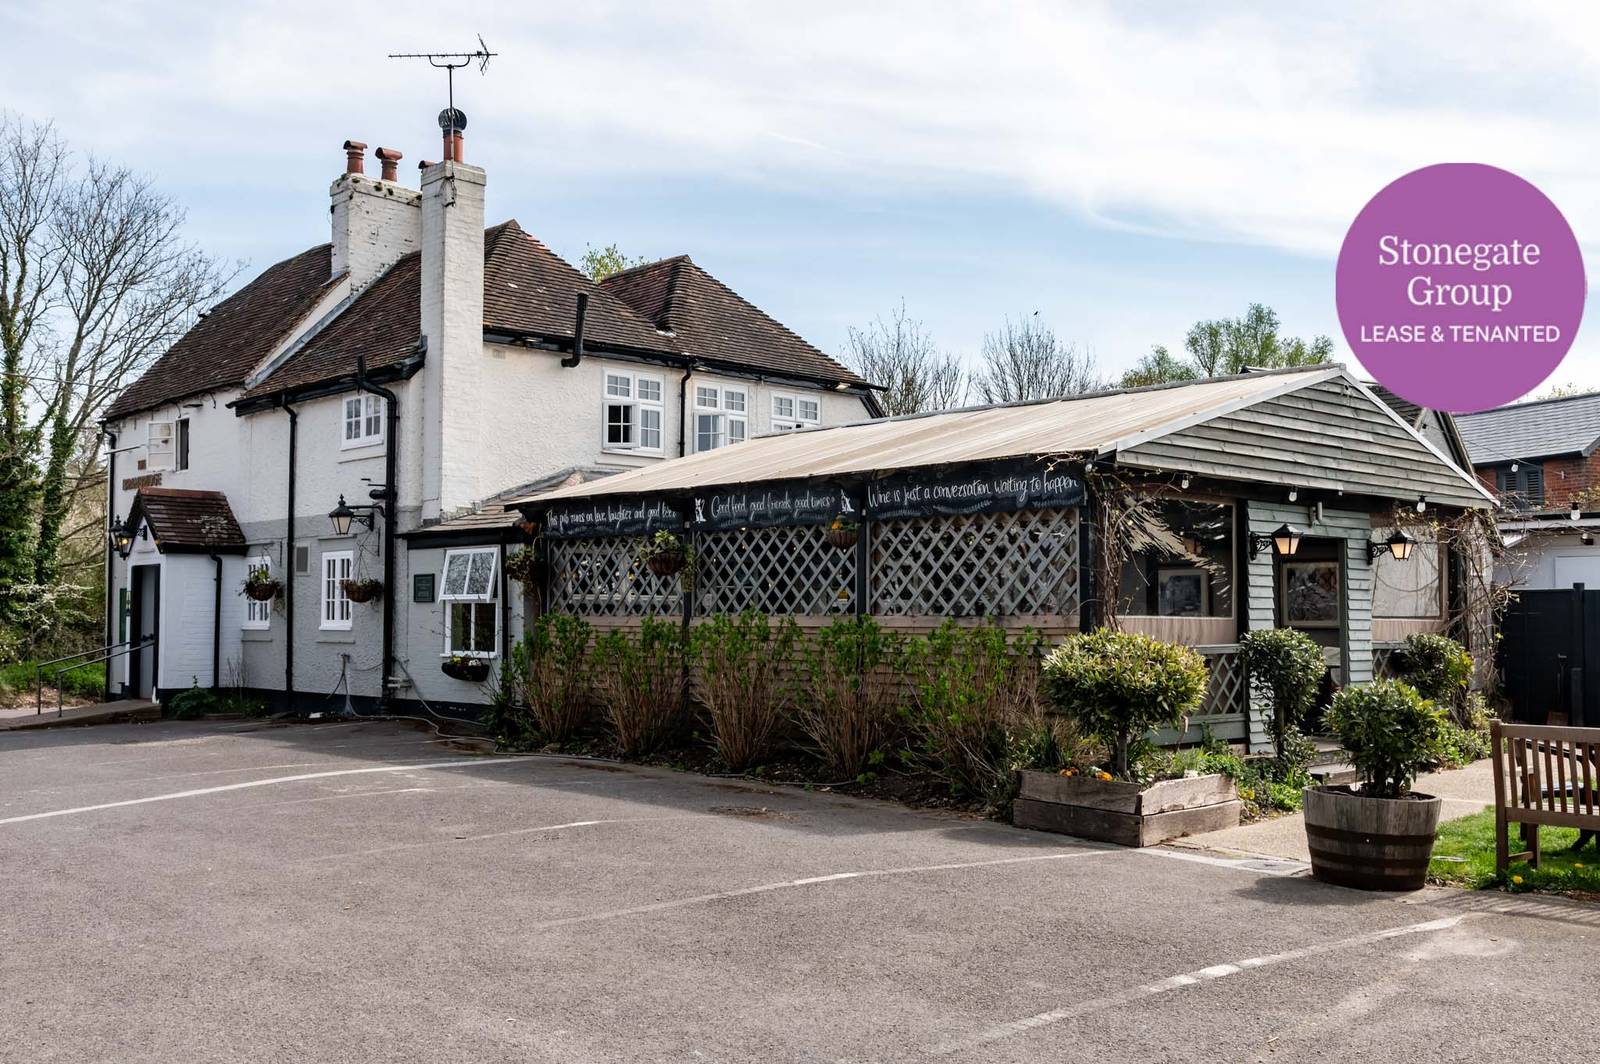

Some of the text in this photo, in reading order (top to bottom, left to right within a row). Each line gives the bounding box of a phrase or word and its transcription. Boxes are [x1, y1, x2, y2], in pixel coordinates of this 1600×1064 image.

[710, 495, 730, 519] Good
[749, 494, 765, 522] good
[794, 490, 810, 519] good
[867, 472, 1079, 508] Wine is just a conversation waiting to happen
[546, 508, 558, 528] This
[560, 509, 570, 534] pub
[571, 513, 585, 523] runs
[586, 512, 594, 521] on
[634, 500, 645, 520] and
[646, 501, 660, 531] good
